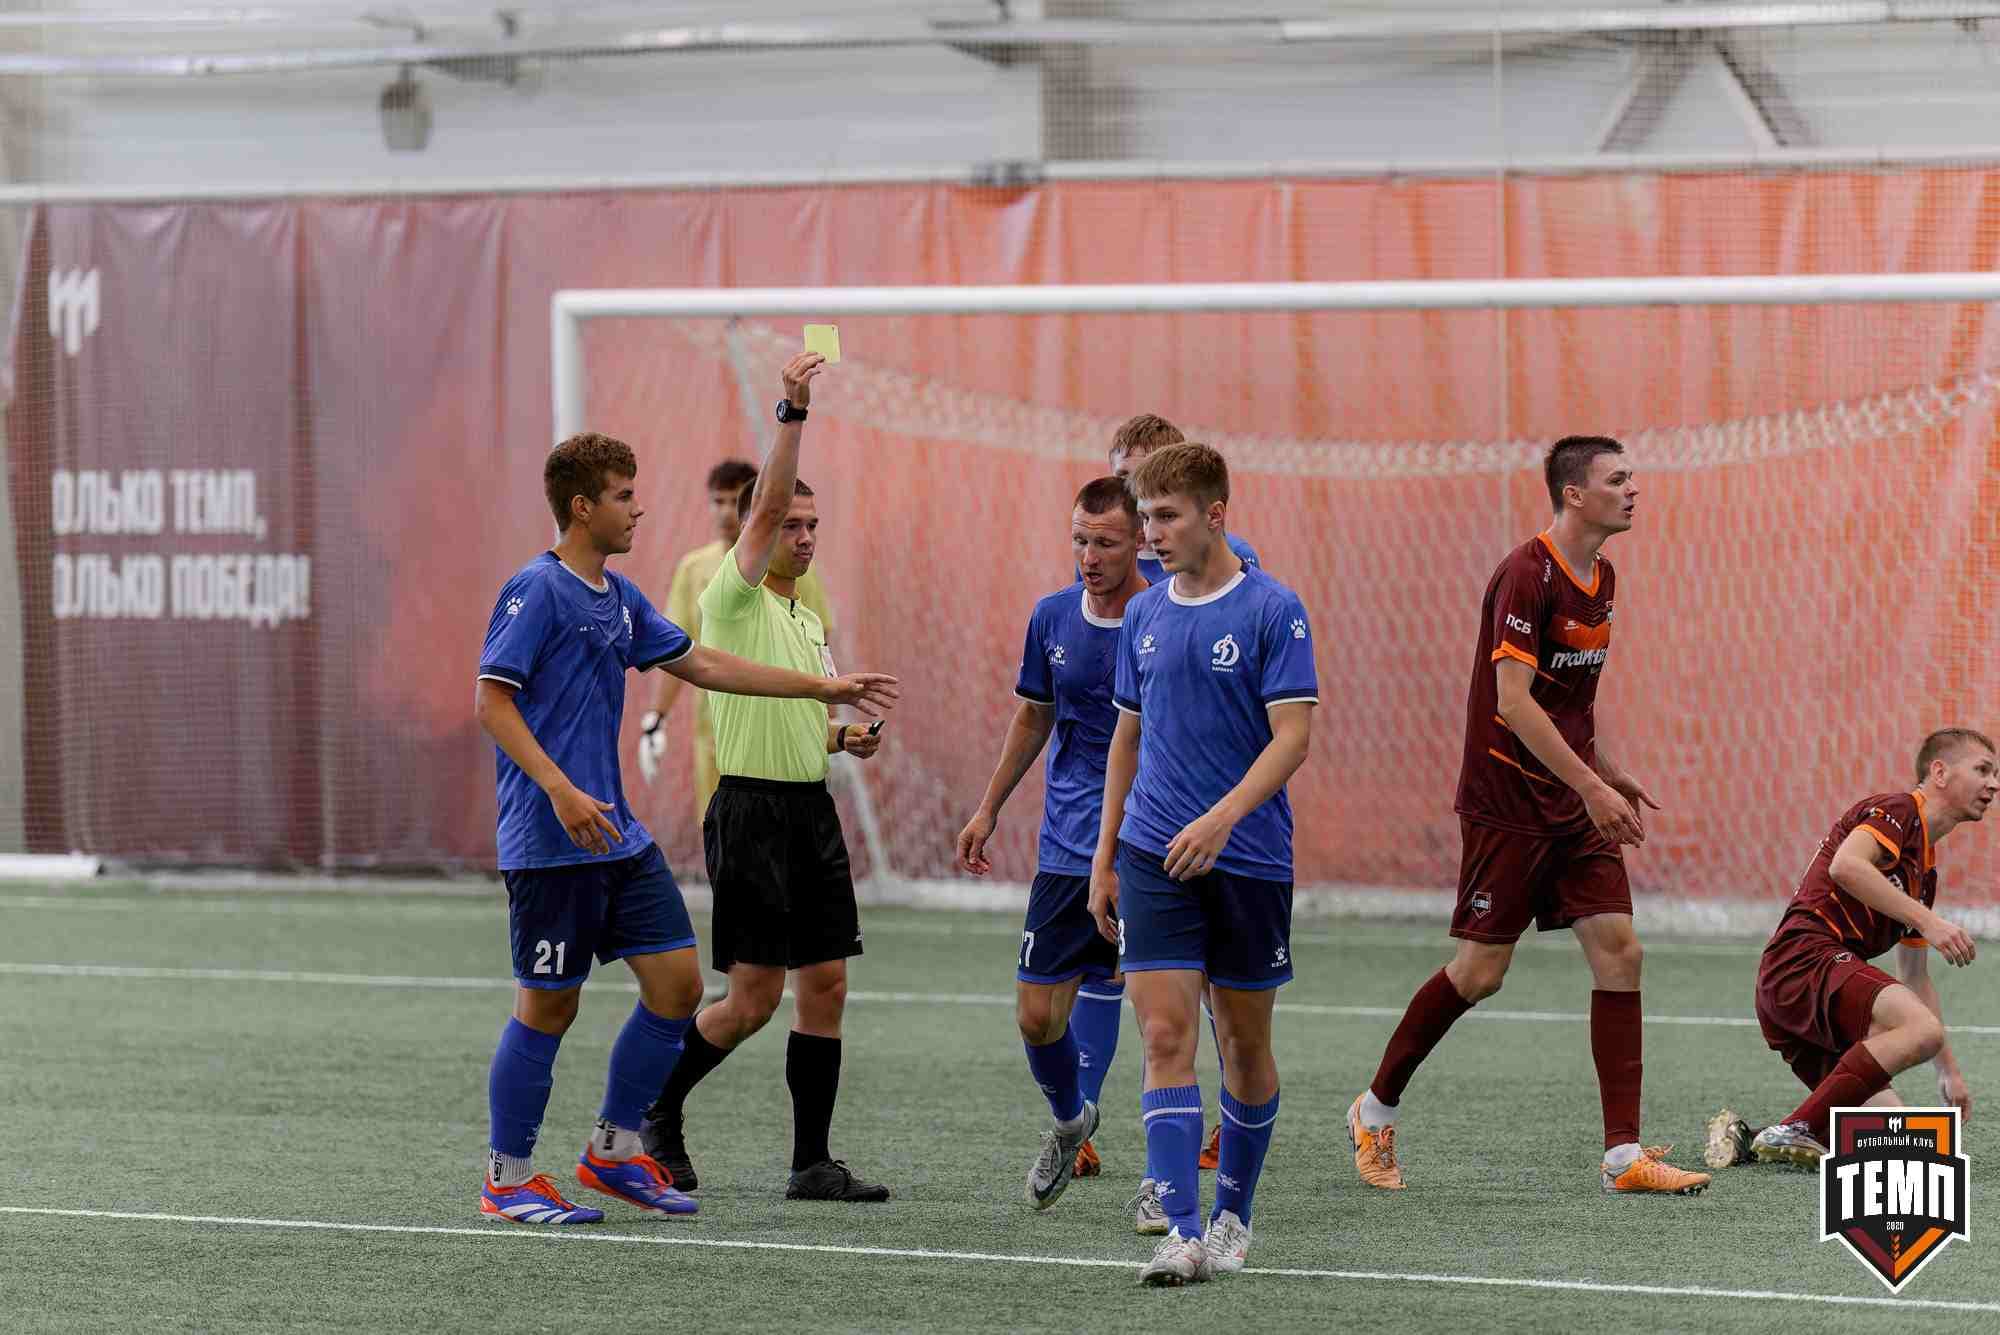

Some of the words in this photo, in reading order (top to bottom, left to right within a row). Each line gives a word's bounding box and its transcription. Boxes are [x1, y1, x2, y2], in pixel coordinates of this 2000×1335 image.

[170, 469, 267, 541] ТЕМП,
[172, 554, 311, 628] ПОБЕДА!
[1505, 613, 1532, 635] ПСБ
[533, 939, 566, 975] 21
